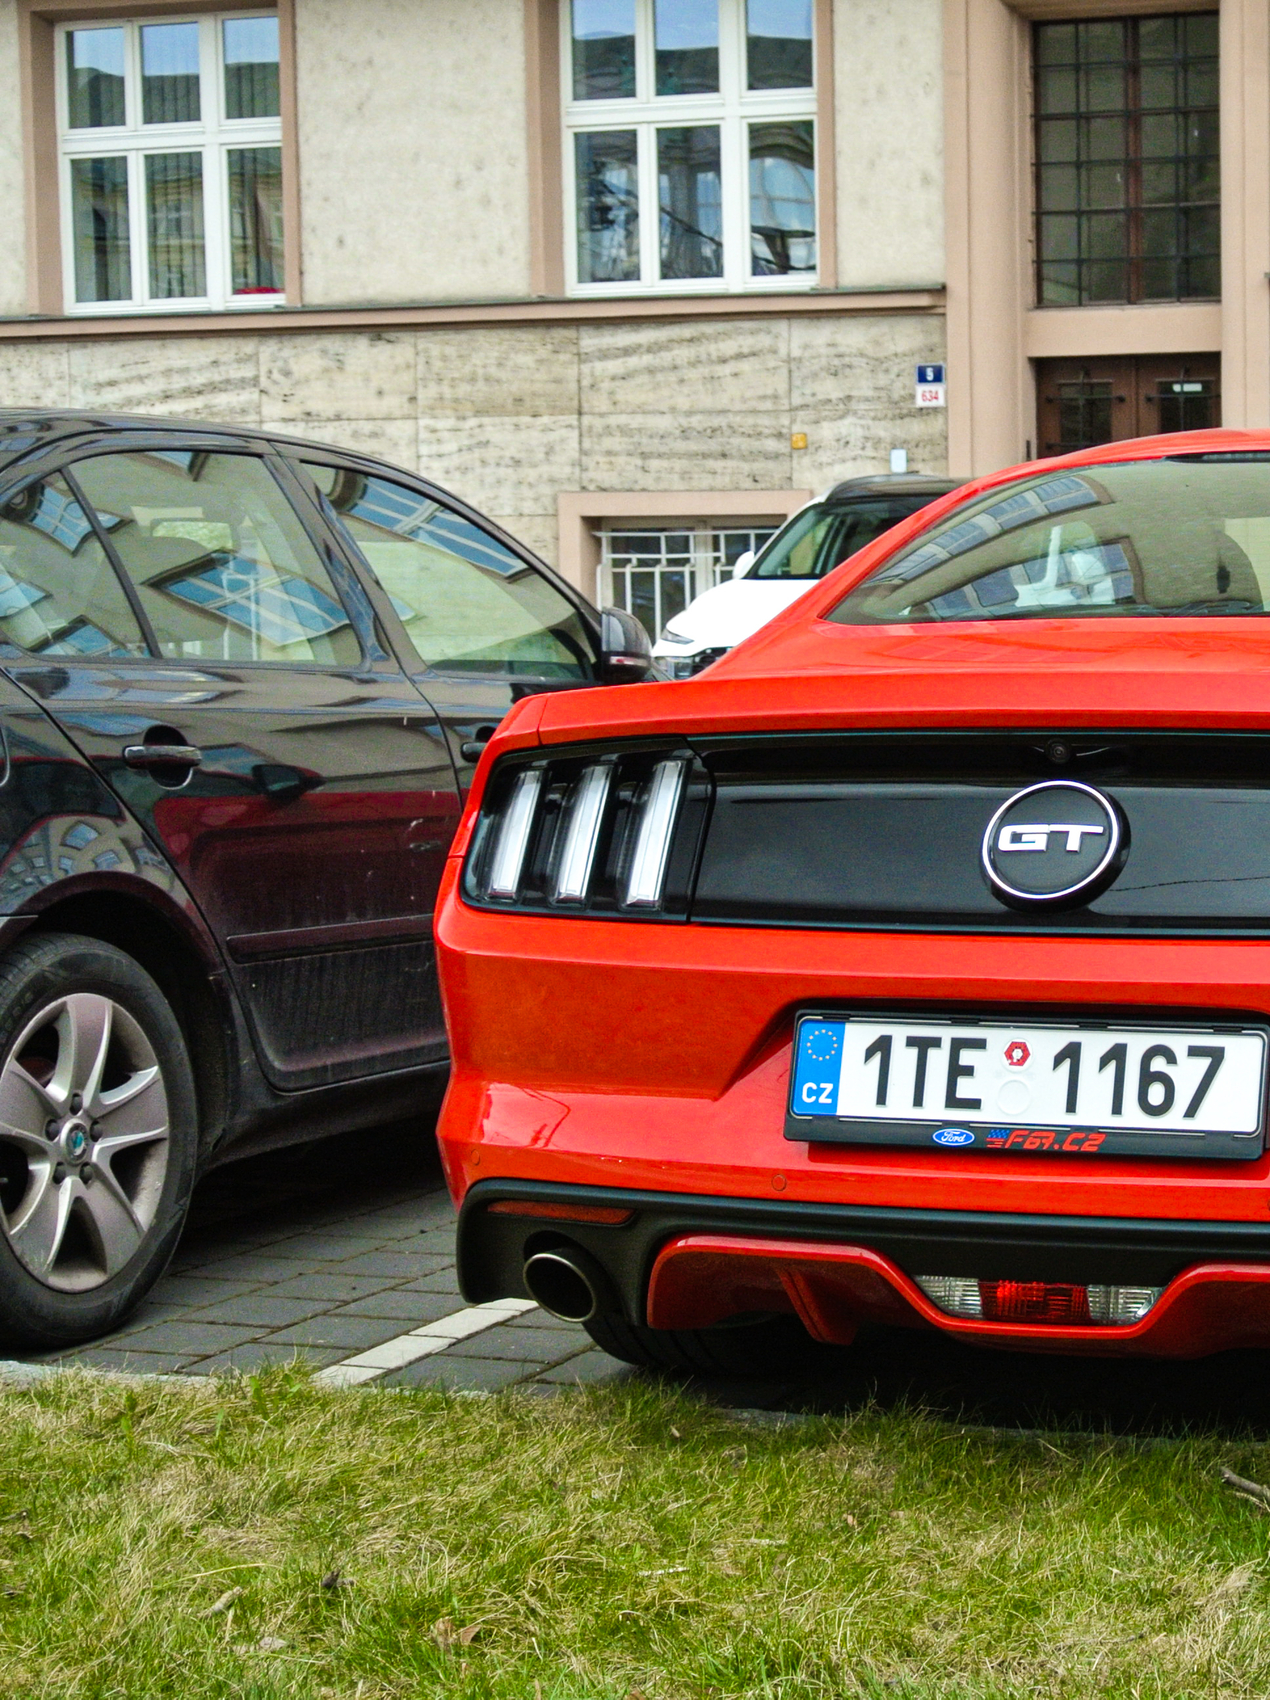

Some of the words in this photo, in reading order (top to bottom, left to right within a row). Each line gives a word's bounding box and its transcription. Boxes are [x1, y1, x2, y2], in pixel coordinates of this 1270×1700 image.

[926, 367, 934, 381] 5
[921, 390, 939, 402] 634
[998, 824, 1104, 852] GT
[864, 1034, 988, 1110] 1TE
[1053, 1041, 1226, 1119] 1167
[802, 1082, 834, 1104] CZ
[940, 1130, 966, 1142] Ford
